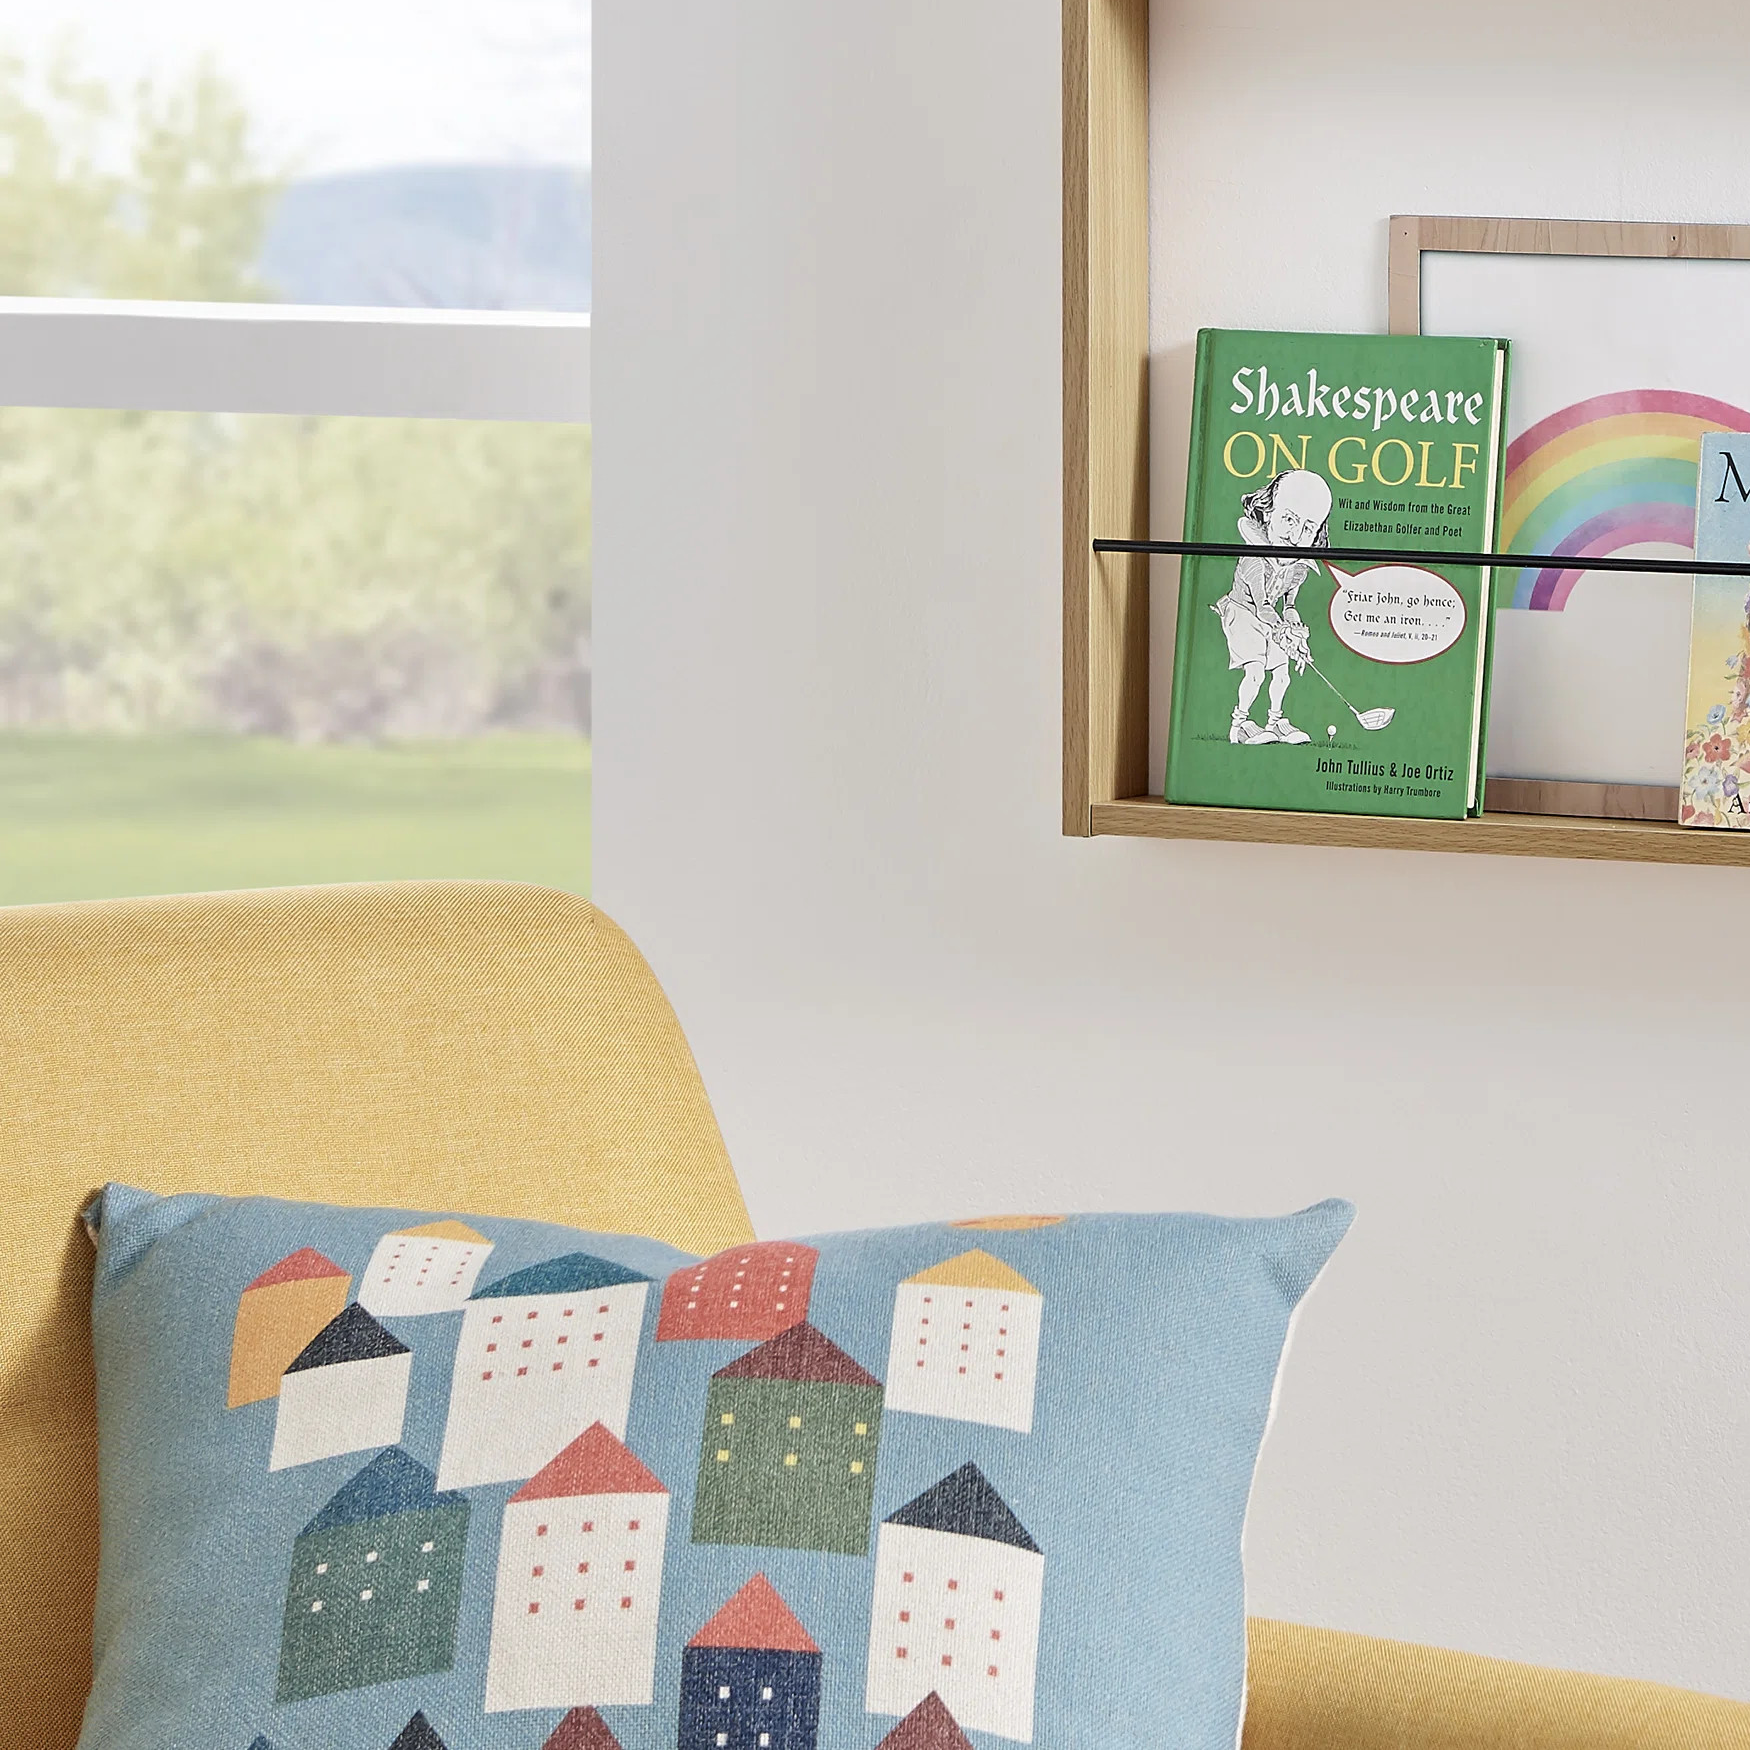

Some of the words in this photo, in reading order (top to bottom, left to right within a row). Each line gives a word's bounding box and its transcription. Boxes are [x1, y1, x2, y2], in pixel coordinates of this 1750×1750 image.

[1230, 365, 1484, 432] Shakespeare
[1223, 431, 1312, 479] ON
[1328, 437, 1480, 489] GOLF
[1338, 498, 1353, 509] Wit
[1354, 499, 1370, 510] and
[1373, 499, 1405, 512] Wisdom
[1408, 501, 1428, 513] from
[1431, 503, 1445, 514] the
[1447, 504, 1471, 516] Great
[1343, 520, 1393, 533] Elizabethan
[1395, 523, 1422, 535] Golfer
[1424, 525, 1440, 536] and
[1442, 526, 1463, 537] Poet
[1375, 592, 1403, 606] John,
[1407, 597, 1420, 608] go
[1343, 610, 1362, 623] Get
[1366, 613, 1381, 623] me
[1383, 615, 1397, 624] an
[1315, 757, 1343, 774] John
[1347, 759, 1385, 777] Tullius
[1389, 762, 1398, 778] &
[1401, 763, 1421, 779] Joe
[1425, 764, 1454, 781] Ortiz
[1325, 780, 1371, 793] Illustrations
[1373, 784, 1382, 796] by
[1383, 784, 1404, 797] Harry
[1406, 786, 1441, 798] Trumbore
